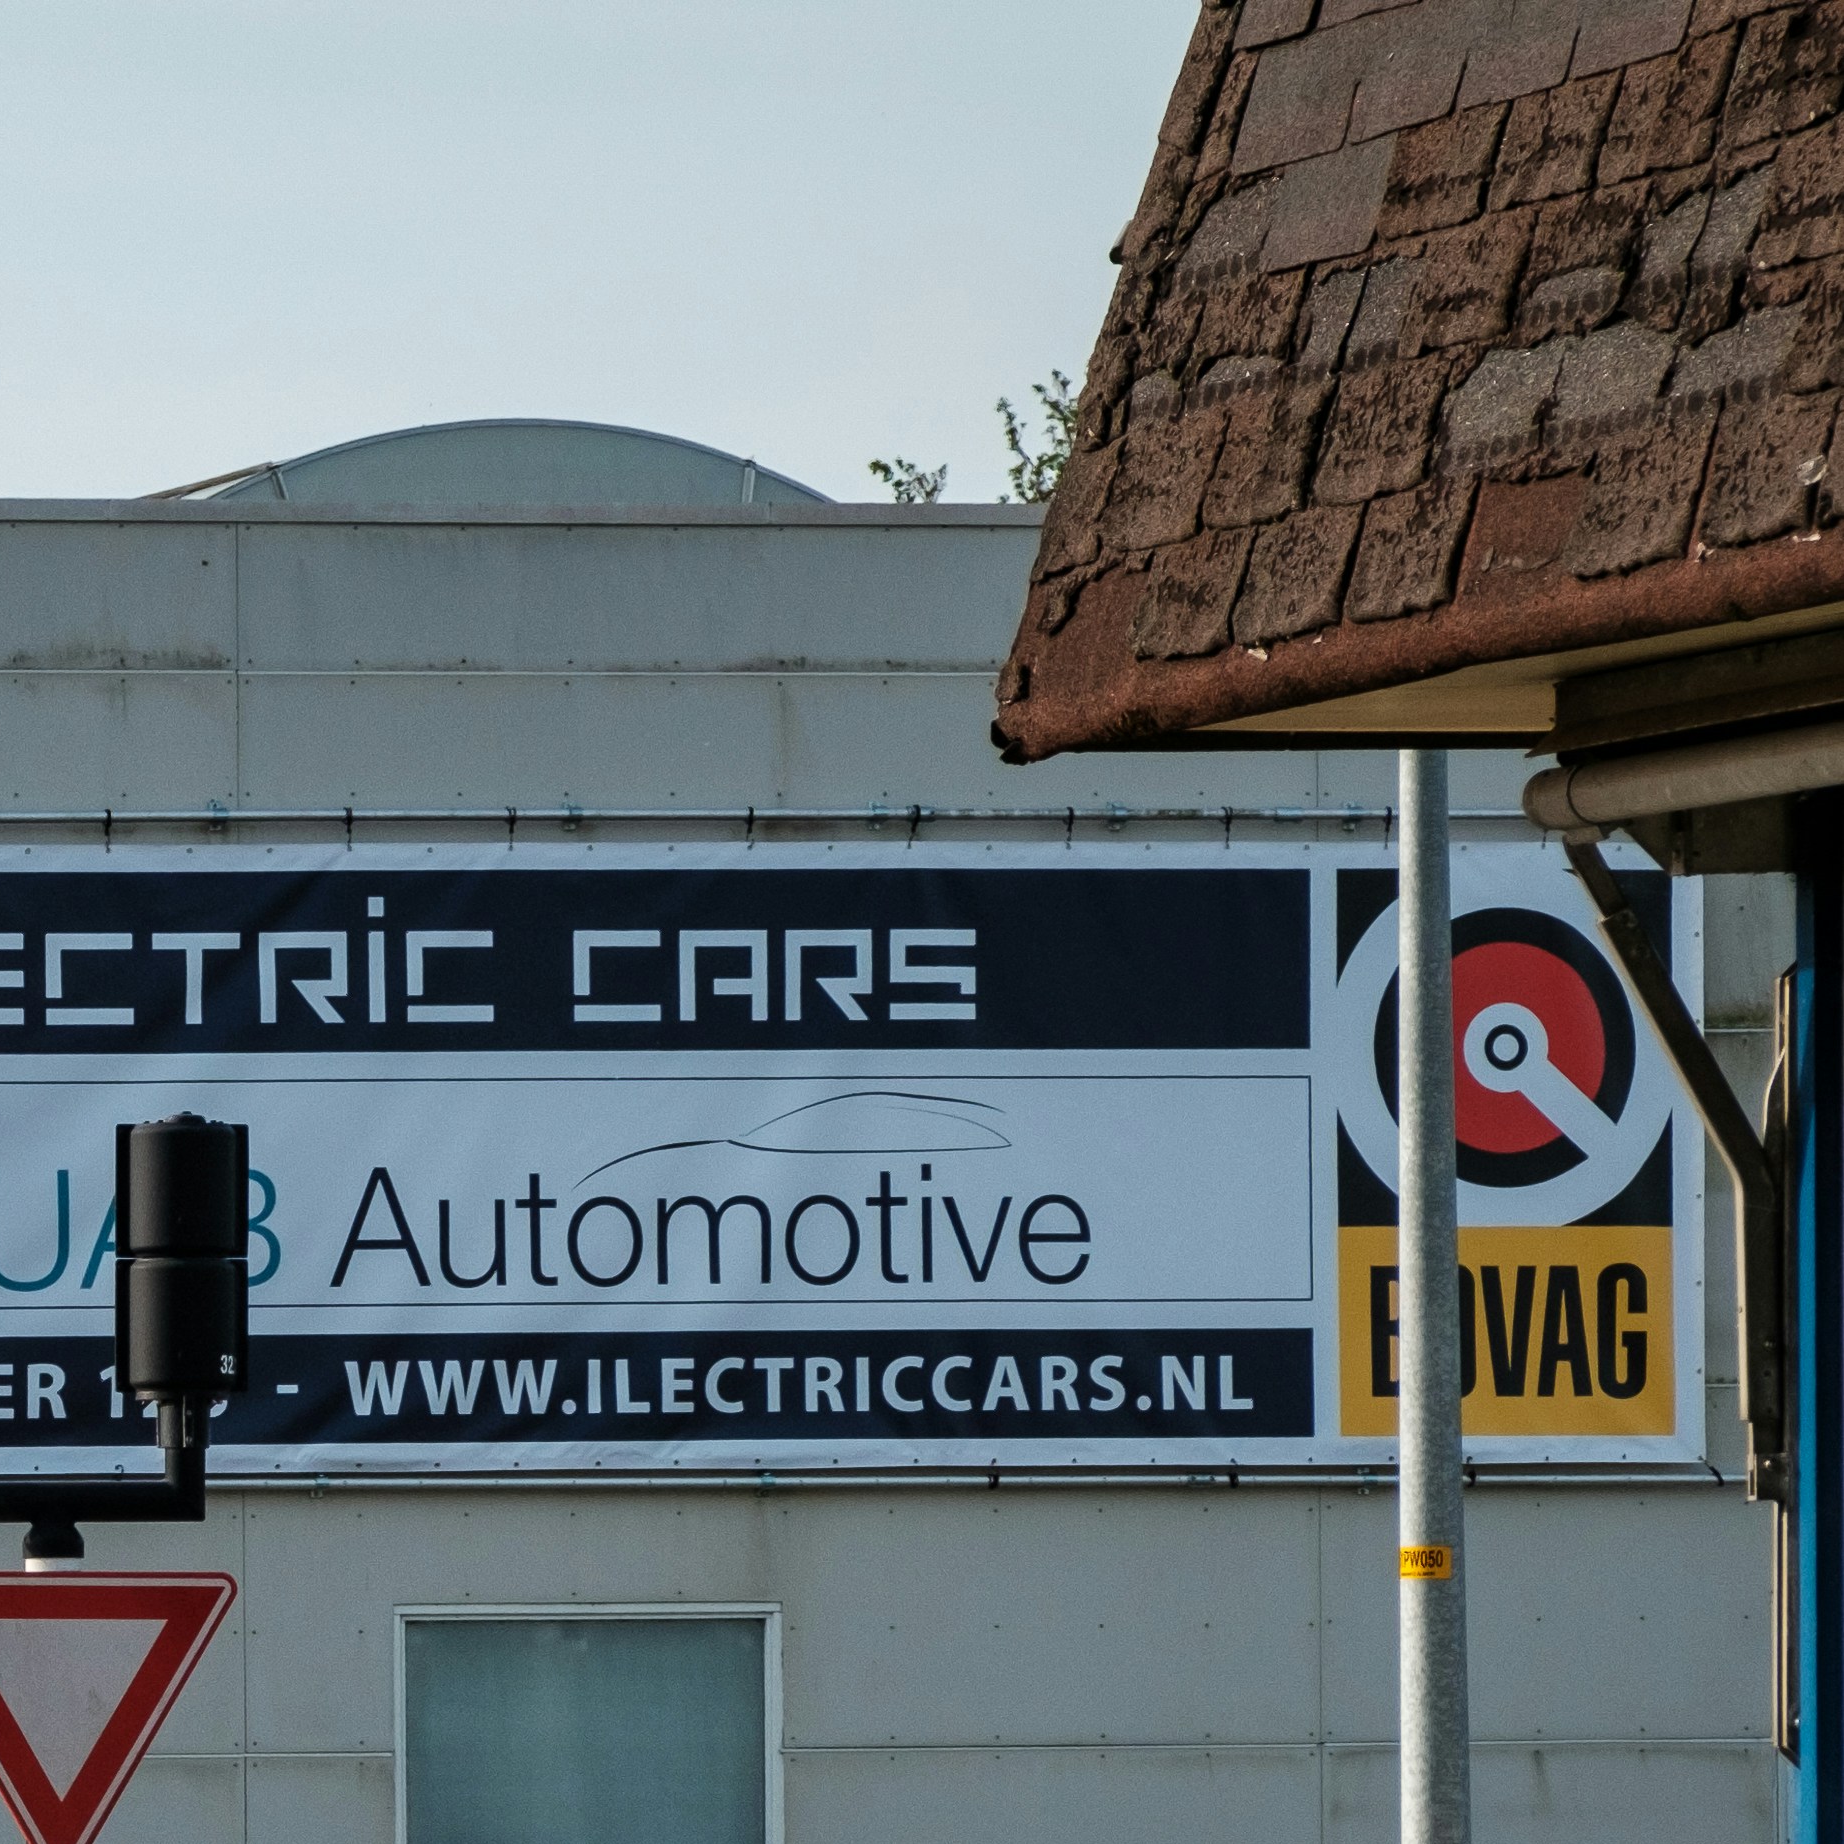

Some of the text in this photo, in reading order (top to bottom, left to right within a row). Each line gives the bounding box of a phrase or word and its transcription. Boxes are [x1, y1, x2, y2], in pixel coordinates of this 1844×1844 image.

[573, 928, 977, 1021] CARS
[330, 1162, 1091, 1290] Automotive
[344, 1354, 1254, 1416] WWW.ILECTRICCARS.NL
